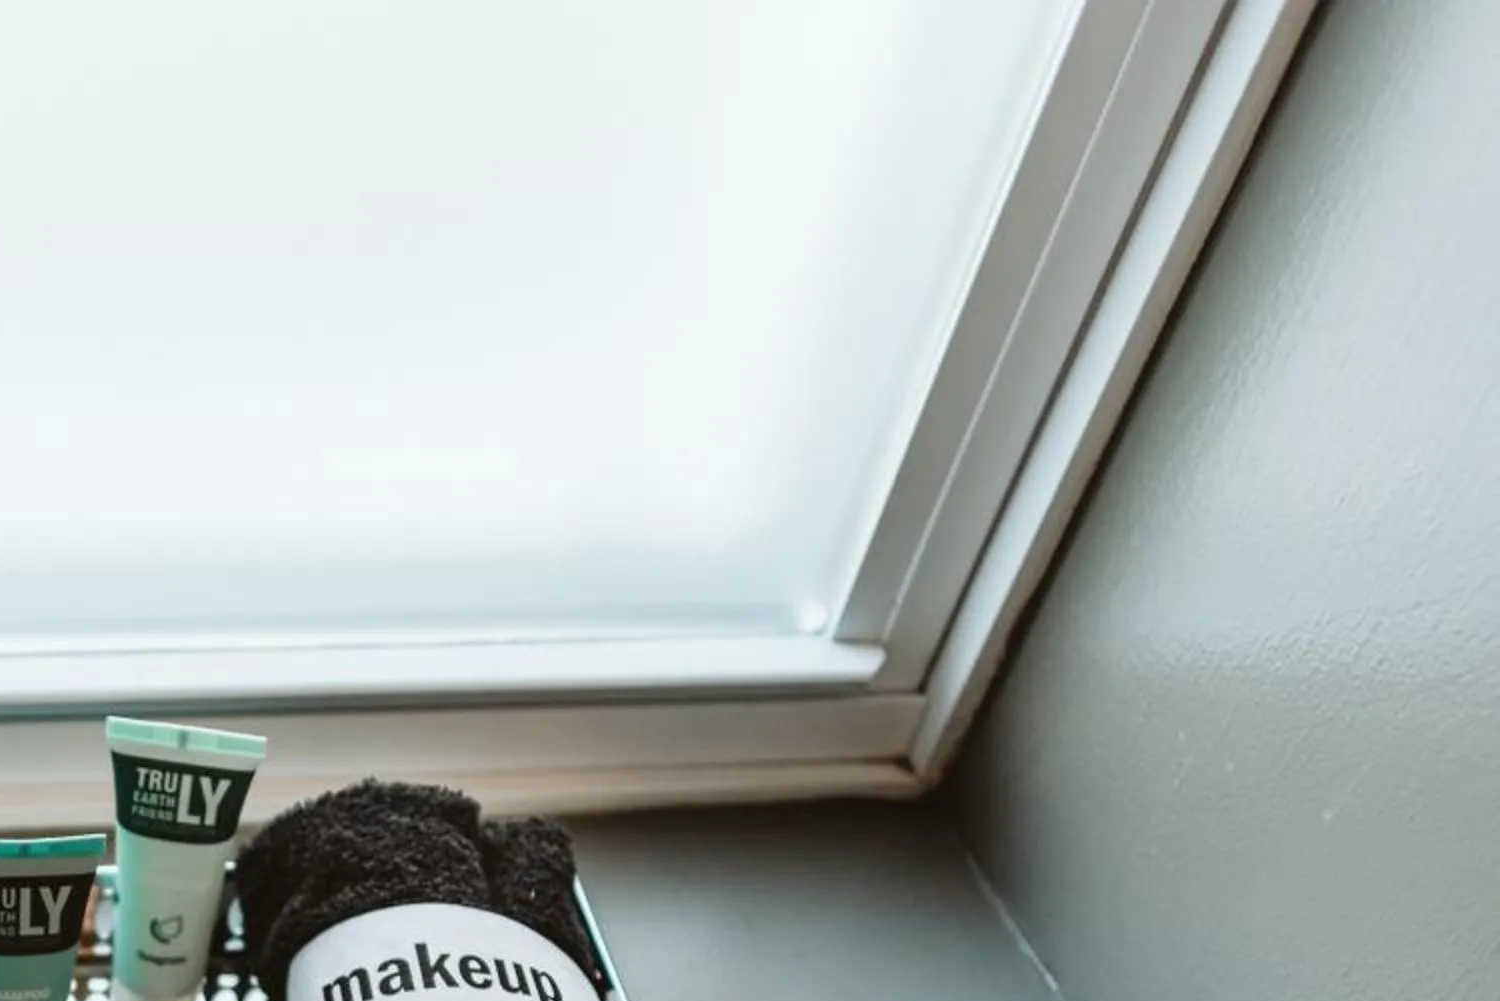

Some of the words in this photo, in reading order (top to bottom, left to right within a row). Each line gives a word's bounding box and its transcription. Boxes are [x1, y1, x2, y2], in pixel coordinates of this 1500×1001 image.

[137, 767, 179, 793] TRU
[177, 773, 232, 827] LY
[19, 885, 73, 936] LY
